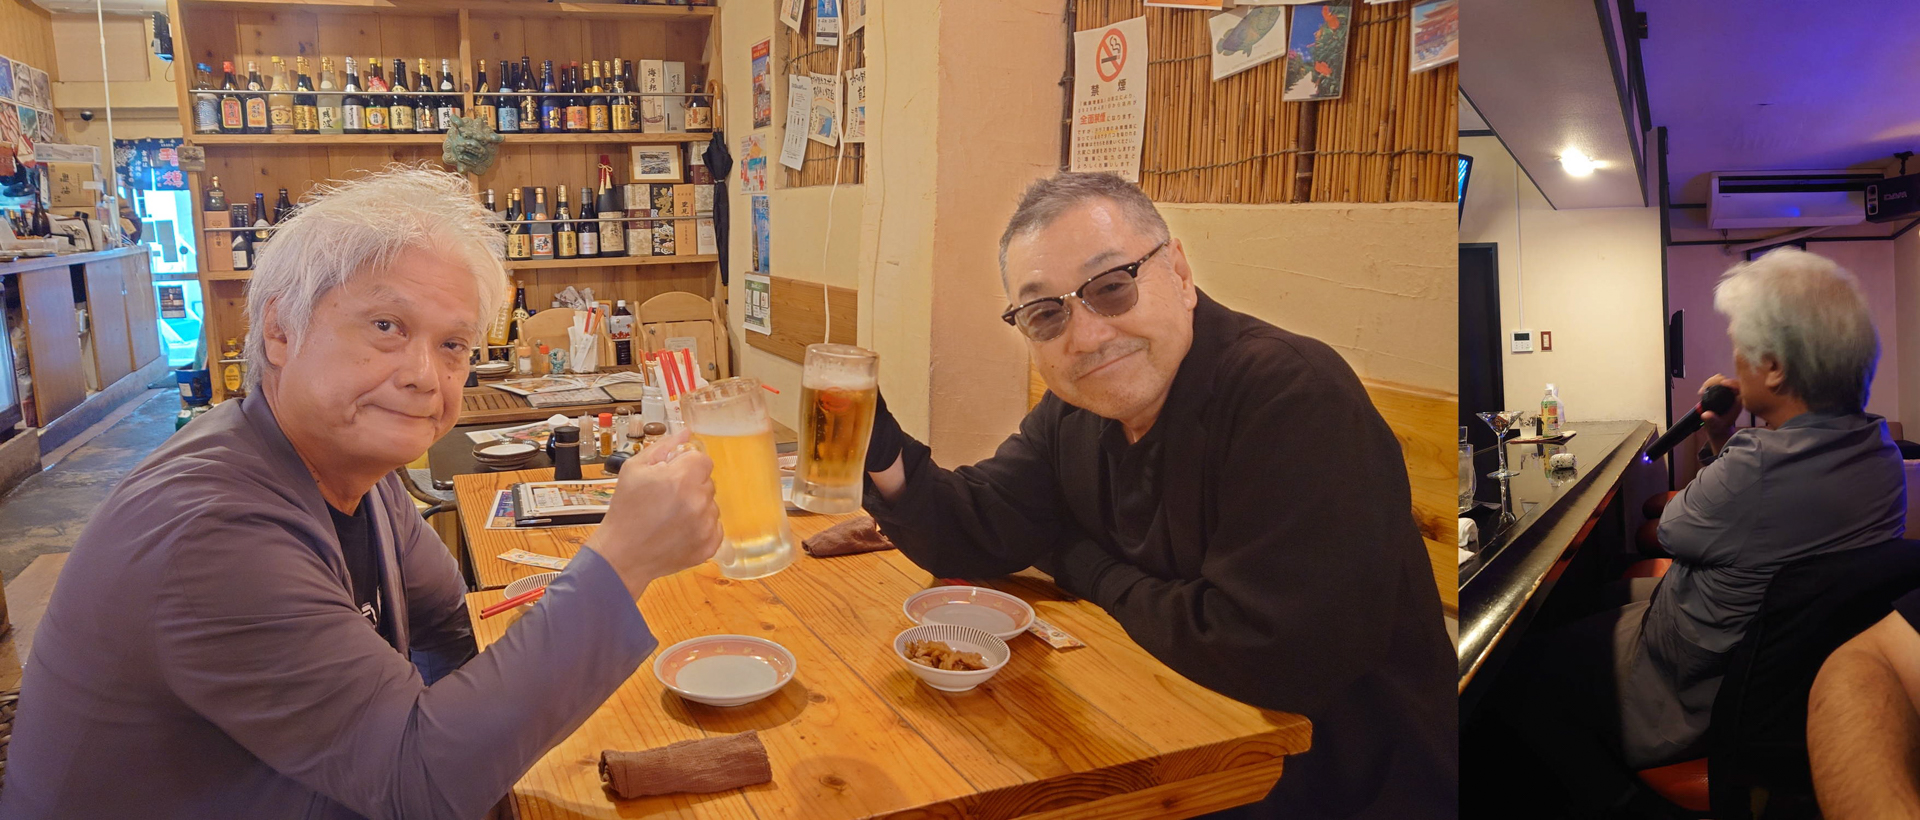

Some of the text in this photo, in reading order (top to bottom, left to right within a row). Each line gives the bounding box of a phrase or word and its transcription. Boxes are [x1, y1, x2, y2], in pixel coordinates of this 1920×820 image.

[647, 67, 657, 92] 海乃邦
[1090, 79, 1127, 97] 禁煙
[395, 107, 404, 126] 八重泉
[506, 108, 516, 129] 瑞泉
